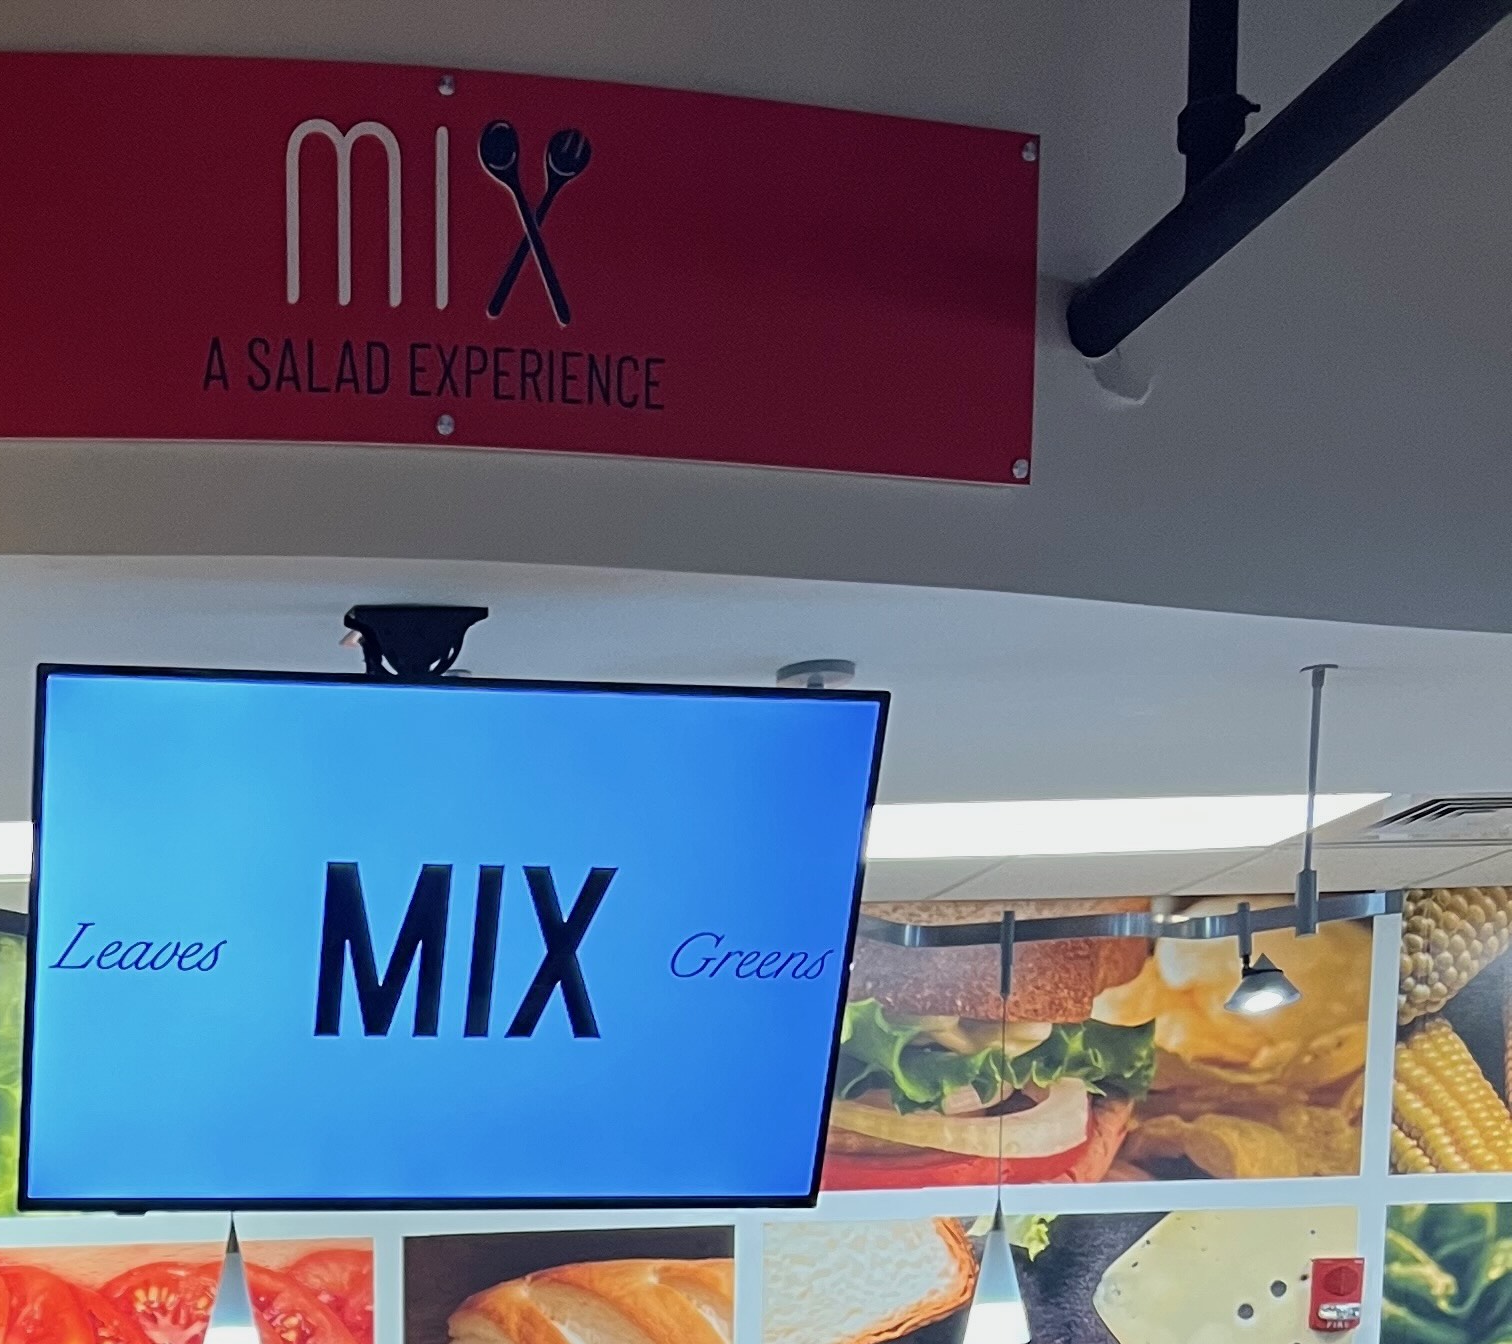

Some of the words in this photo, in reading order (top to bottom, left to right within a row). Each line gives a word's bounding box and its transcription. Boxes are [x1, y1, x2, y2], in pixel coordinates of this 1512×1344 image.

[202, 335, 229, 392] A
[247, 336, 390, 395] SALAD
[409, 342, 666, 411] EXPERIENCE
[48, 921, 228, 972] Leaves
[313, 862, 619, 1039] MIX
[669, 931, 835, 982] Greens
